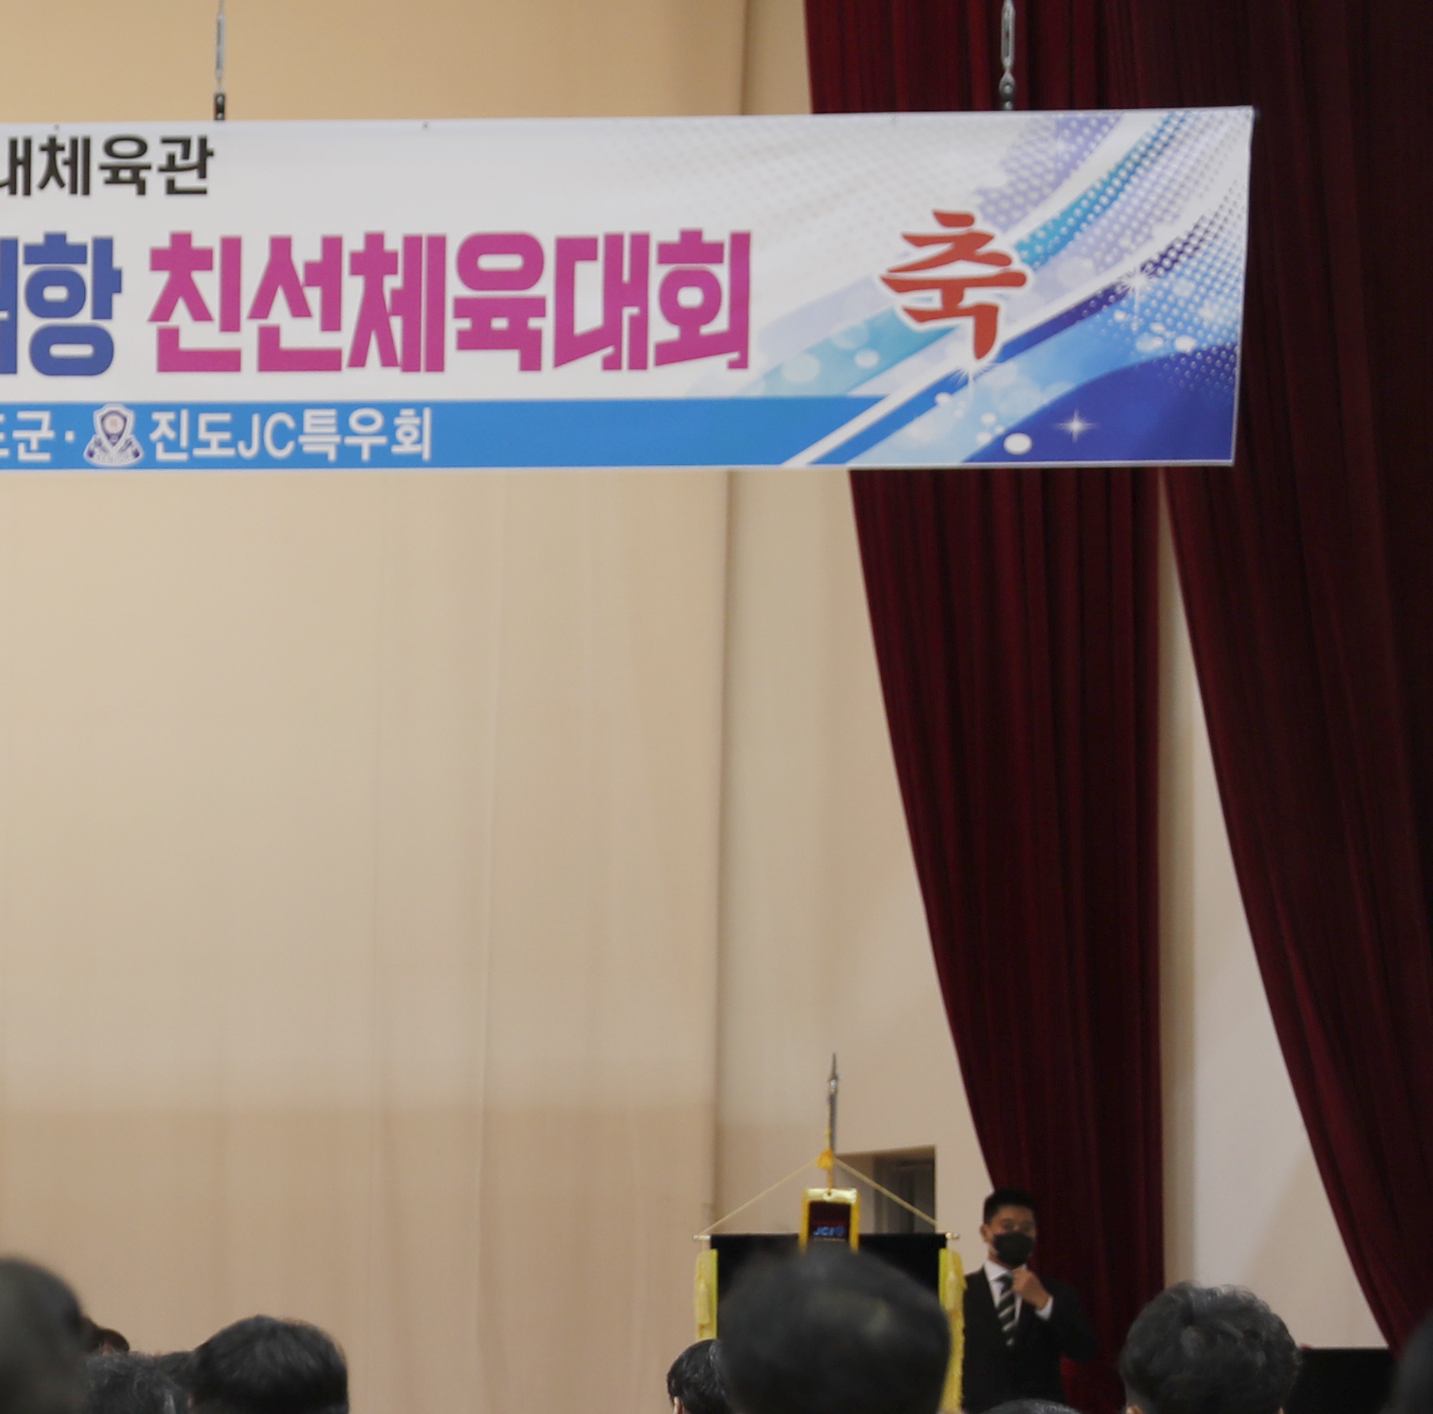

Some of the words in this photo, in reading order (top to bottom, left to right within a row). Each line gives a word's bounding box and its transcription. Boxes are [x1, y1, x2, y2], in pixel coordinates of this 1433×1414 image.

[150, 230, 752, 373] 친선체육대회
[881, 211, 1027, 360] 축
[149, 407, 434, 463] 진도JC특우회
